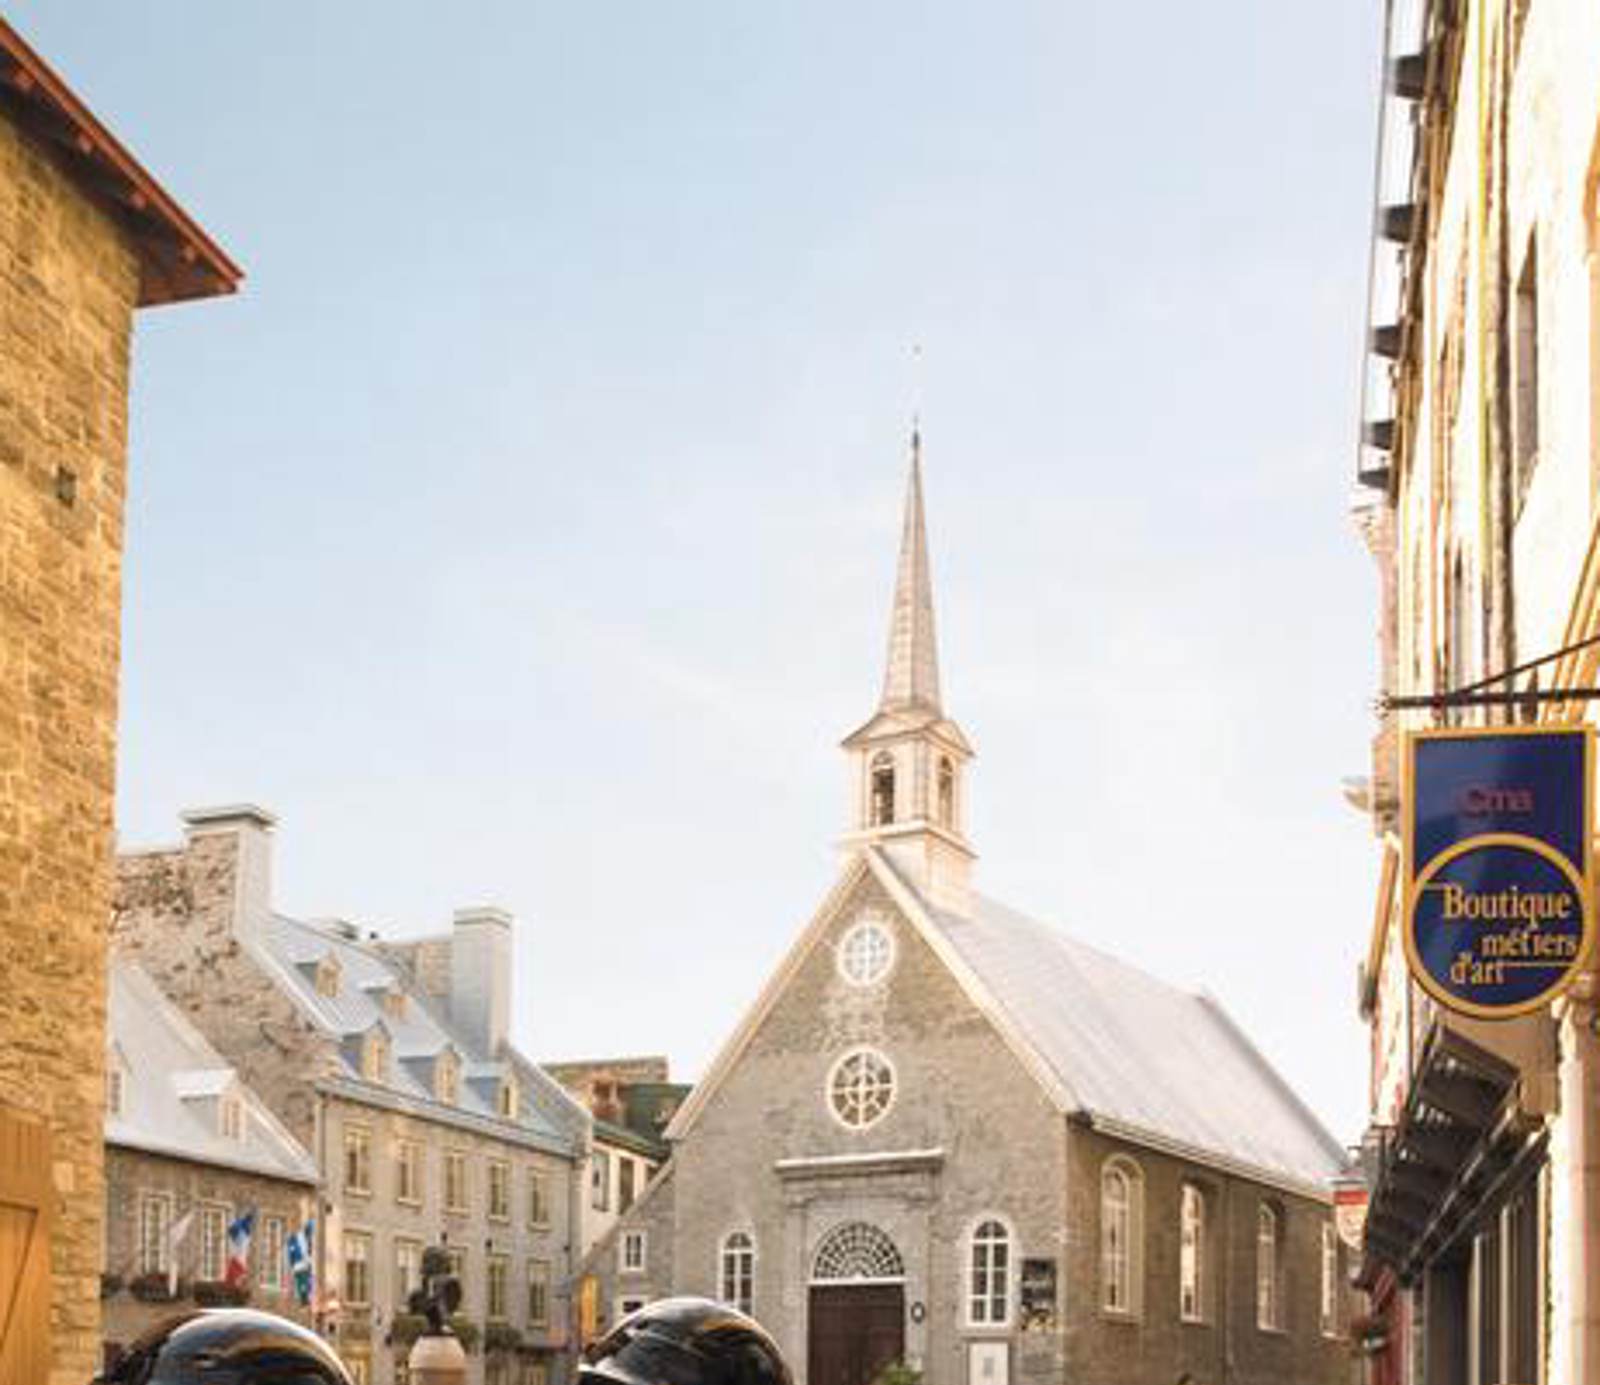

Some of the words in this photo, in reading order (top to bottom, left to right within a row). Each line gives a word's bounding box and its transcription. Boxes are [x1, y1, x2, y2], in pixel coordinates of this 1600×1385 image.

[1443, 885, 1572, 929] Boutique
[1481, 929, 1577, 956] métiers
[1451, 952, 1504, 984] d'art
